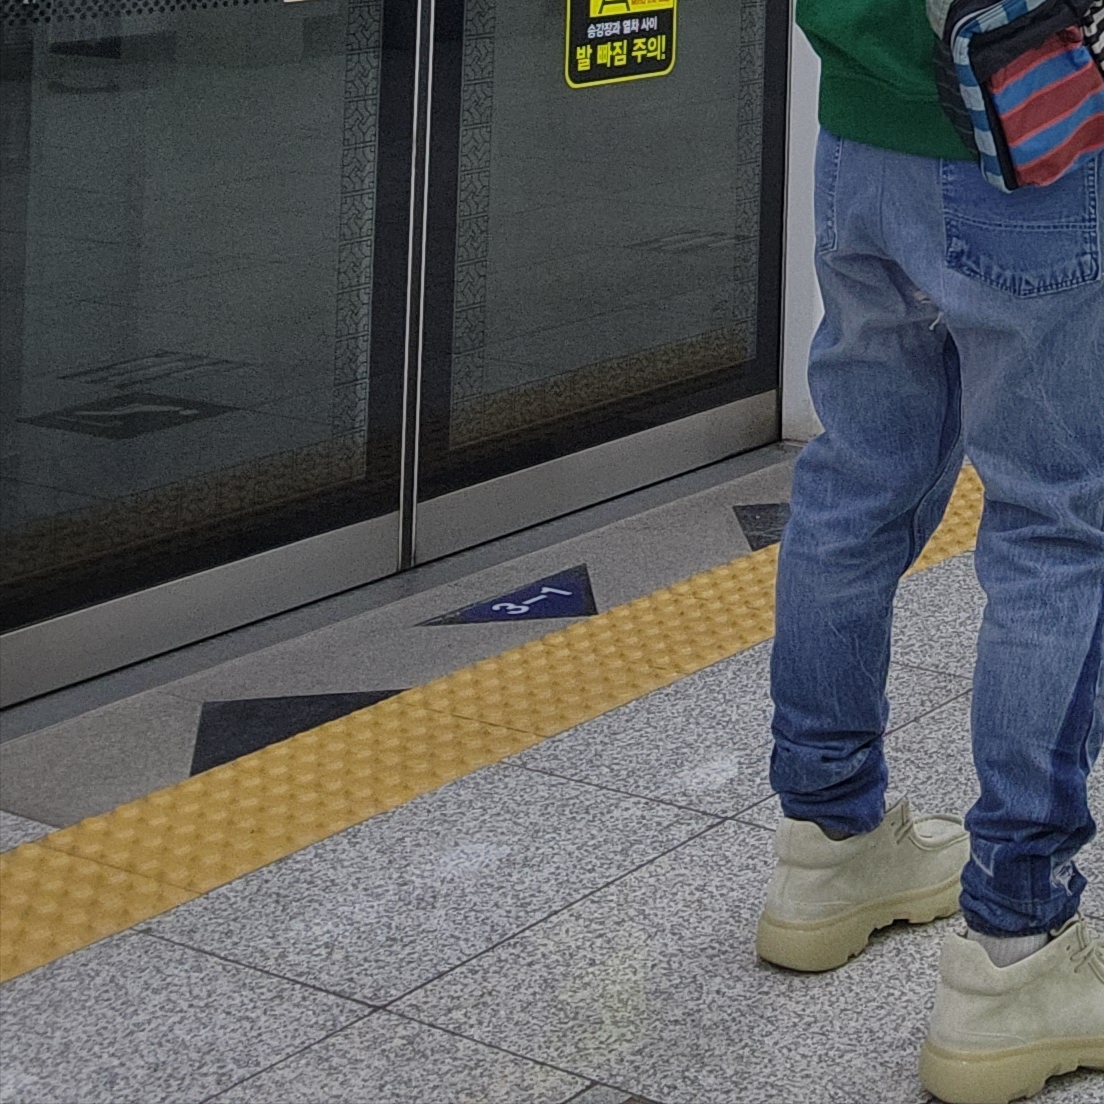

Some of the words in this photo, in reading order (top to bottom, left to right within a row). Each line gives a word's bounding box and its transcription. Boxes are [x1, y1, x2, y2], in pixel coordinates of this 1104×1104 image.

[587, 20, 622, 39] 승강장과
[622, 17, 640, 36] 열차
[640, 15, 658, 32] 사이
[575, 44, 593, 72] 발
[597, 39, 628, 68] 빠짐
[631, 34, 667, 64] 주의!
[491, 586, 573, 615] 3-1
